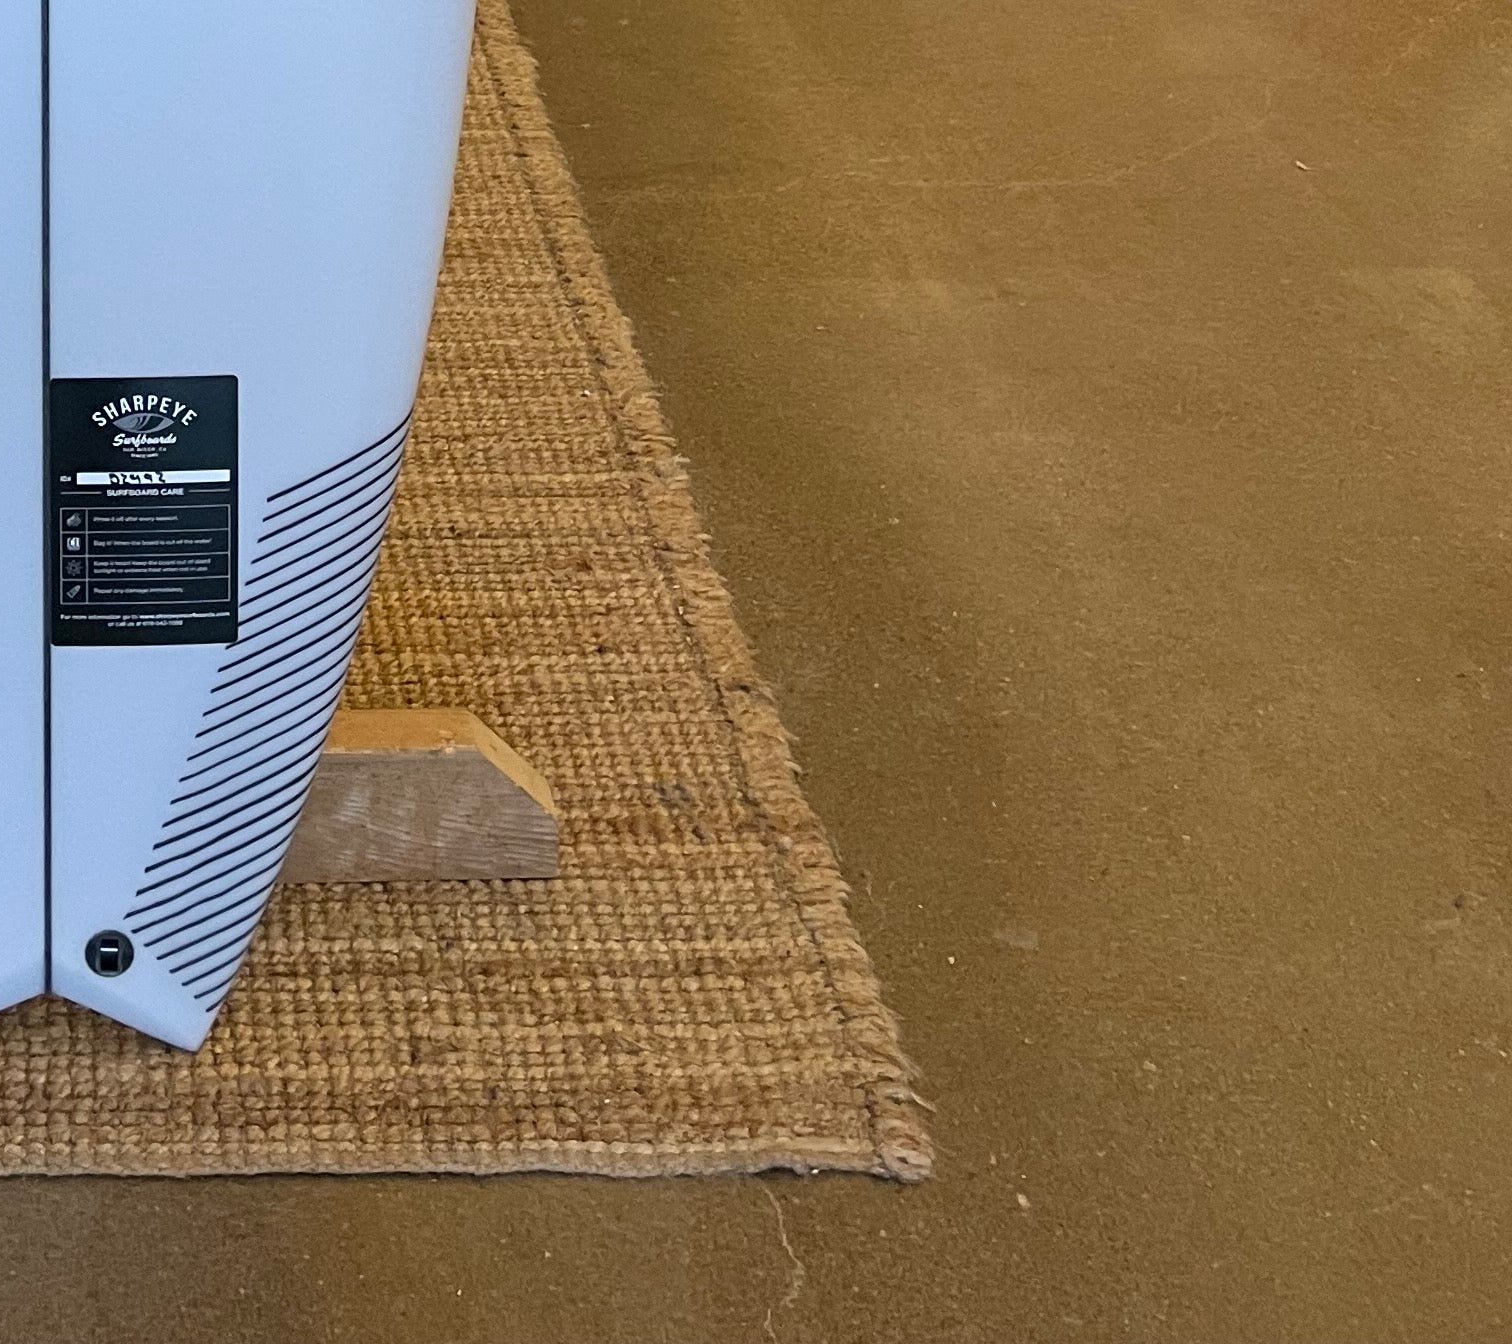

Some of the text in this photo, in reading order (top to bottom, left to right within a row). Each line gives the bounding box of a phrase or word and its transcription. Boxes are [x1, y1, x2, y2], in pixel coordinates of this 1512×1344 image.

[91, 394, 198, 427] SHARPEYE
[112, 432, 177, 447] Surfboards
[107, 488, 185, 497] SURFBOARD CARE
